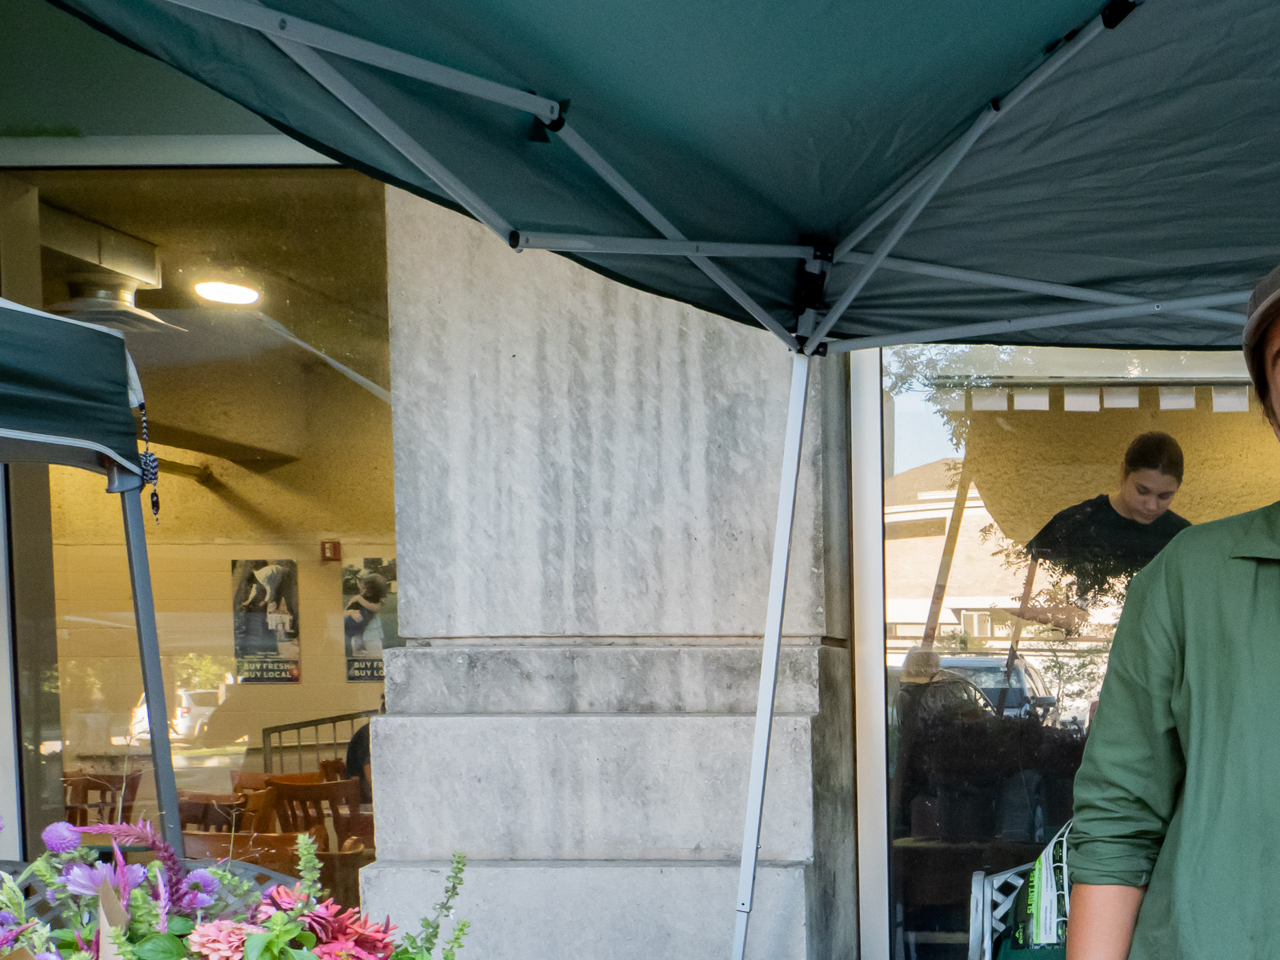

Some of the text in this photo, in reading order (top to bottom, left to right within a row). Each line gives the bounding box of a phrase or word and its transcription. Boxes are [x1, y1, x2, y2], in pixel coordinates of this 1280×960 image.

[243, 662, 290, 671] BUY FRESH
[354, 661, 371, 669] BUY
[244, 671, 292, 679] BUY LOCAL
[354, 669, 371, 677] BUY
